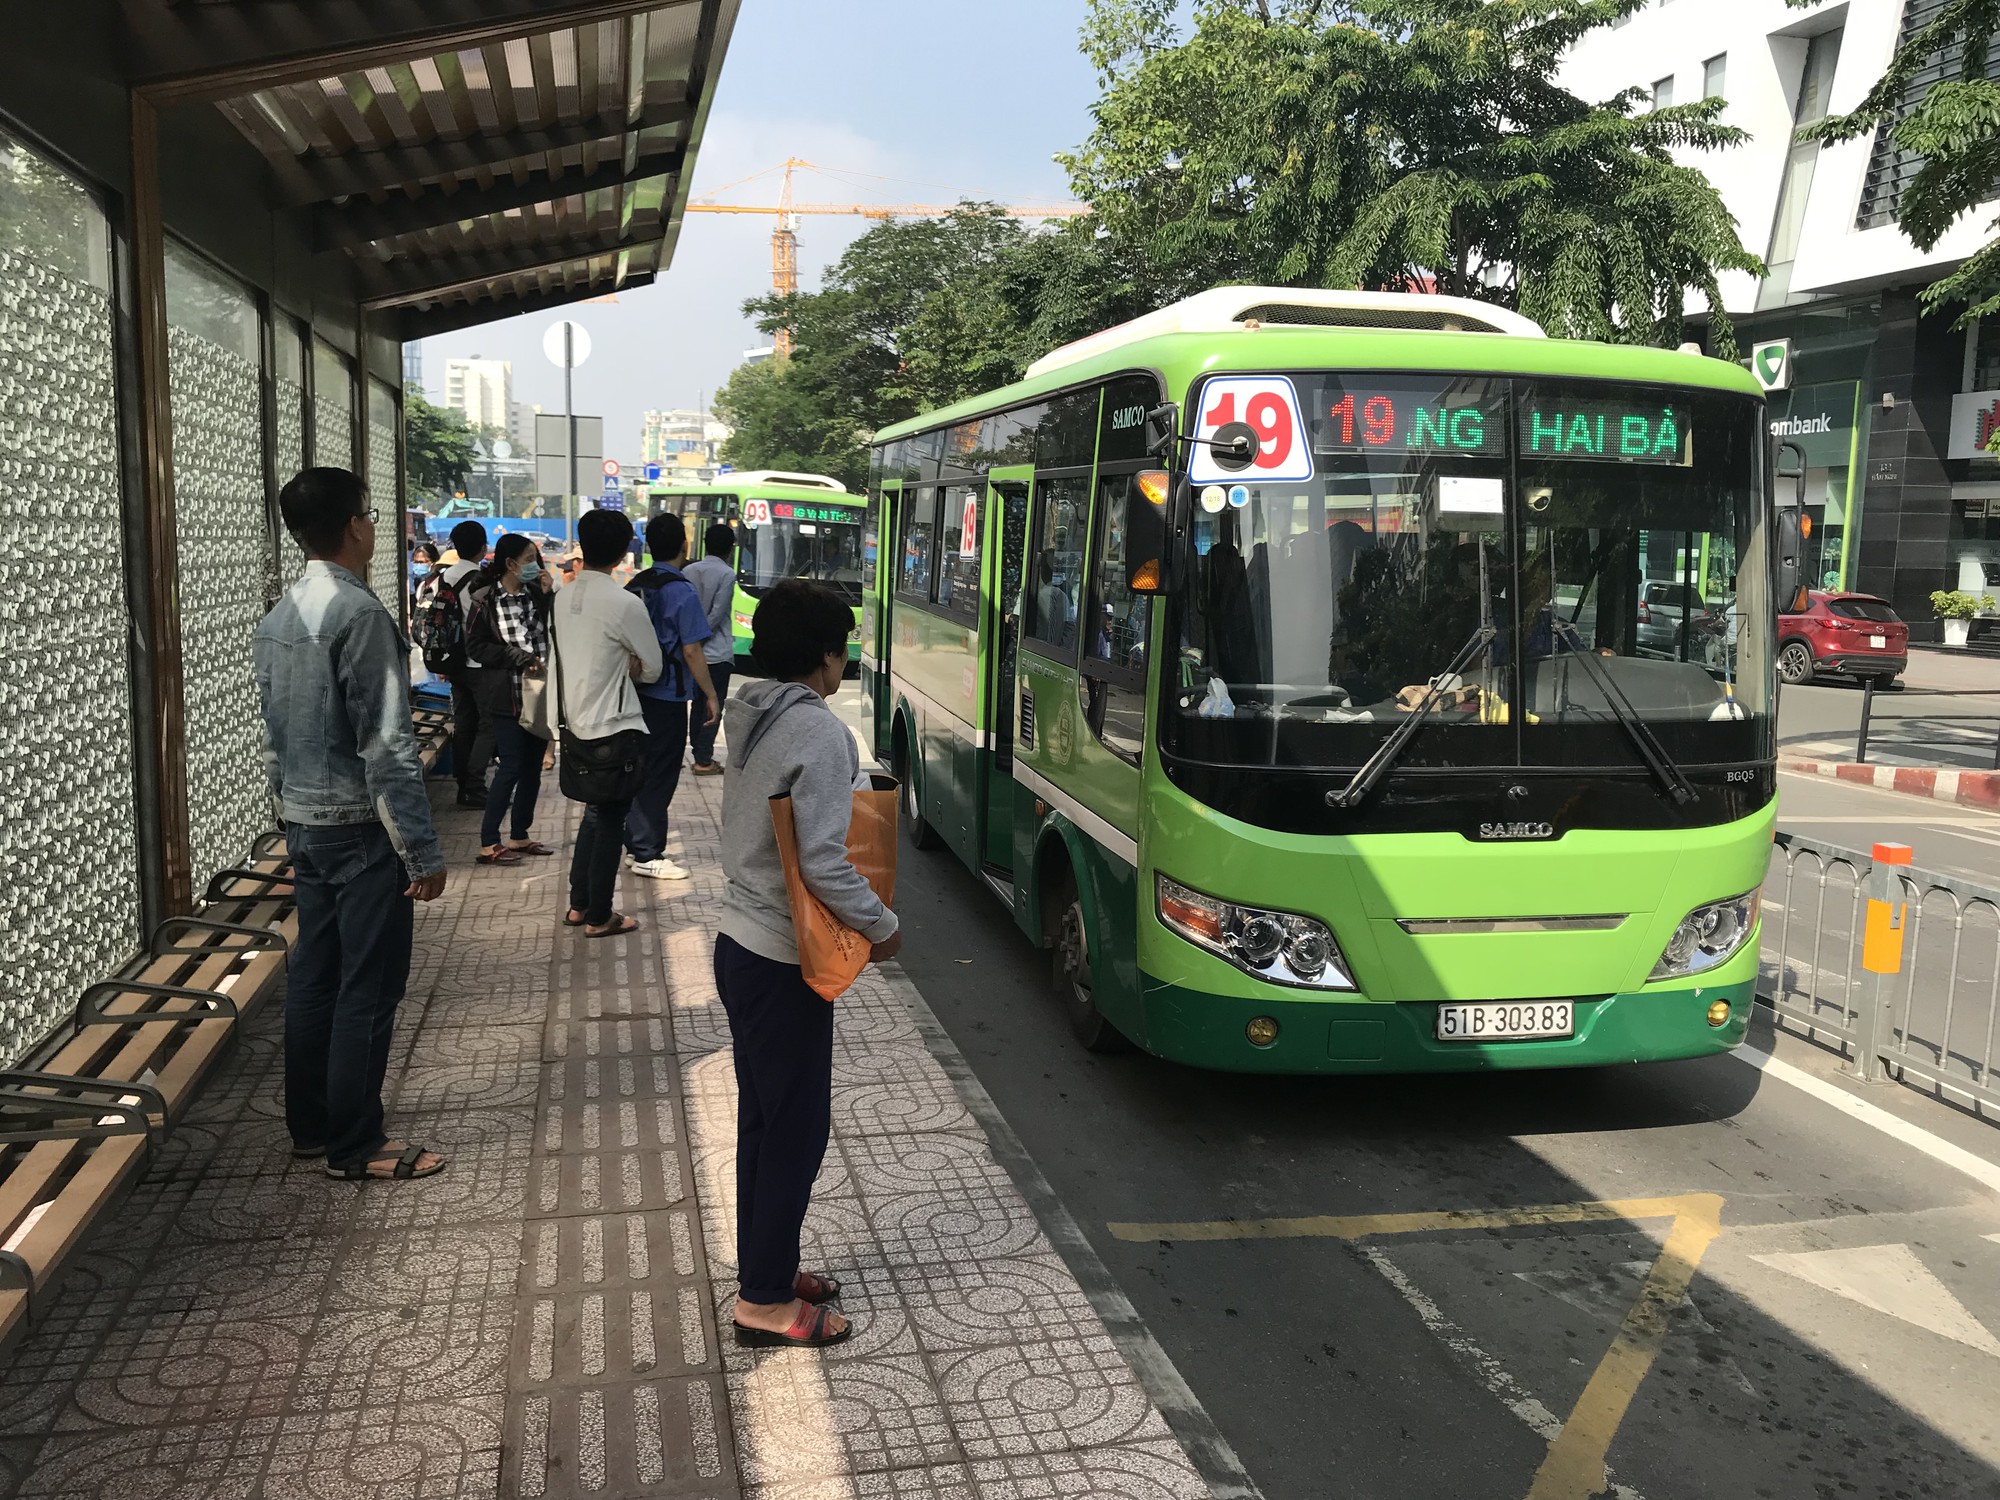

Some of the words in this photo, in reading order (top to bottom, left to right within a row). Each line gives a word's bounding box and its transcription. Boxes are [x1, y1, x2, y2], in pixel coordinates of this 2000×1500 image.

[1112, 404, 1145, 430] SAMCO
[1206, 391, 1293, 469] 19
[1331, 394, 1395, 444] 19
[1406, 407, 1484, 447] NG
[1532, 412, 1605, 453] HAI
[1621, 408, 1677, 455] BÀ
[747, 503, 767, 521] 03
[774, 503, 794, 517] 03
[963, 502, 975, 551] 19
[1726, 769, 1755, 783] BGQ5
[1480, 822, 1554, 838] SAMCO
[1444, 1005, 1569, 1034] 51B-303.83
